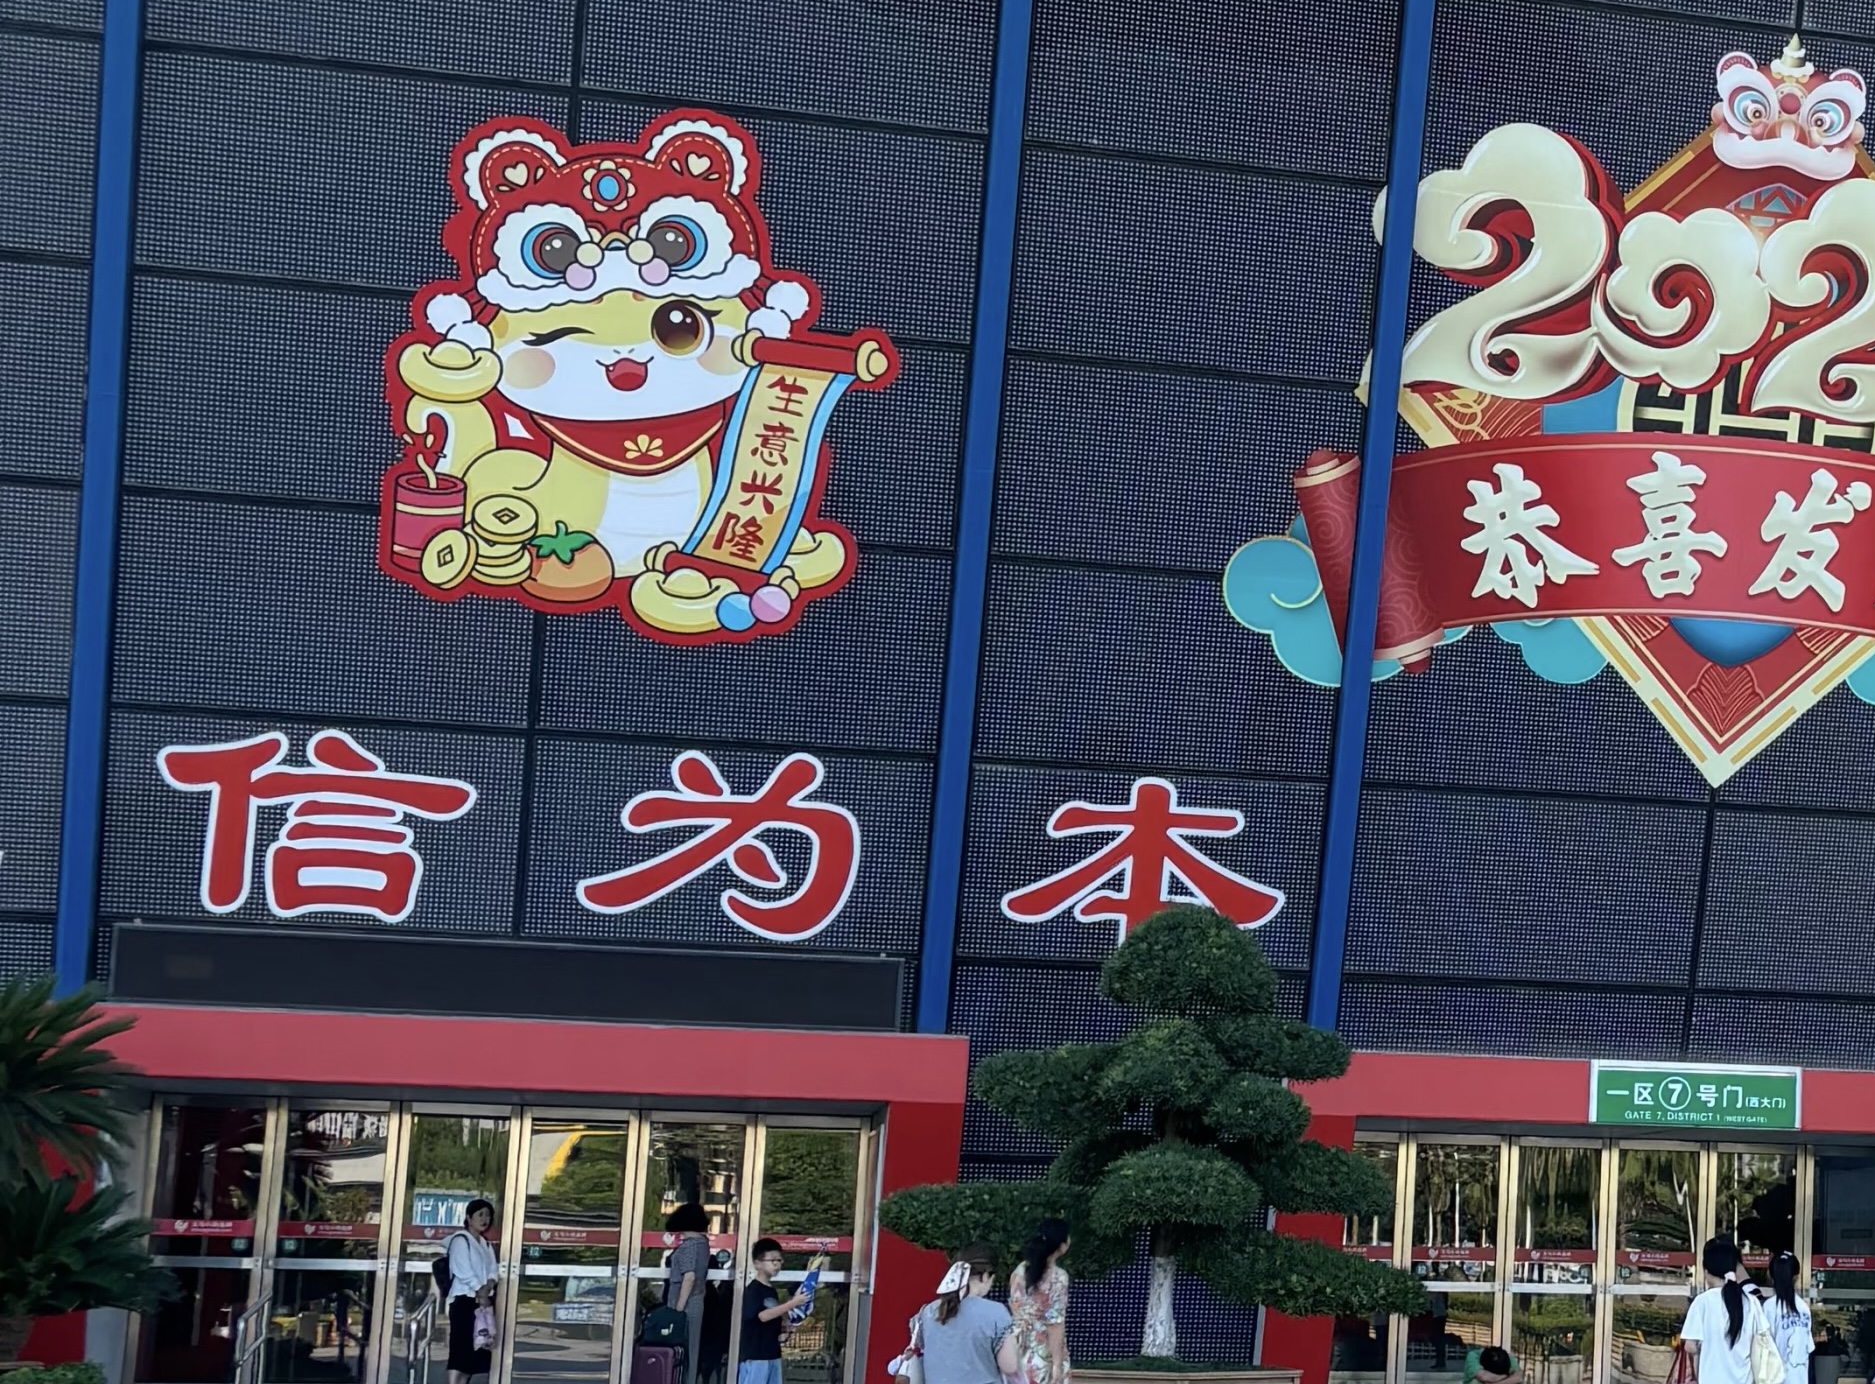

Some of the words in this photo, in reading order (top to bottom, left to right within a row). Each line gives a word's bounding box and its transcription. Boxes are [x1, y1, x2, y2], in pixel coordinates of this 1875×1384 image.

[711, 373, 809, 565] 生意兴隆
[157, 727, 1286, 948] 信为本
[1624, 1110, 1652, 1120] GATE
[1667, 1111, 1713, 1122] DISTRICT
